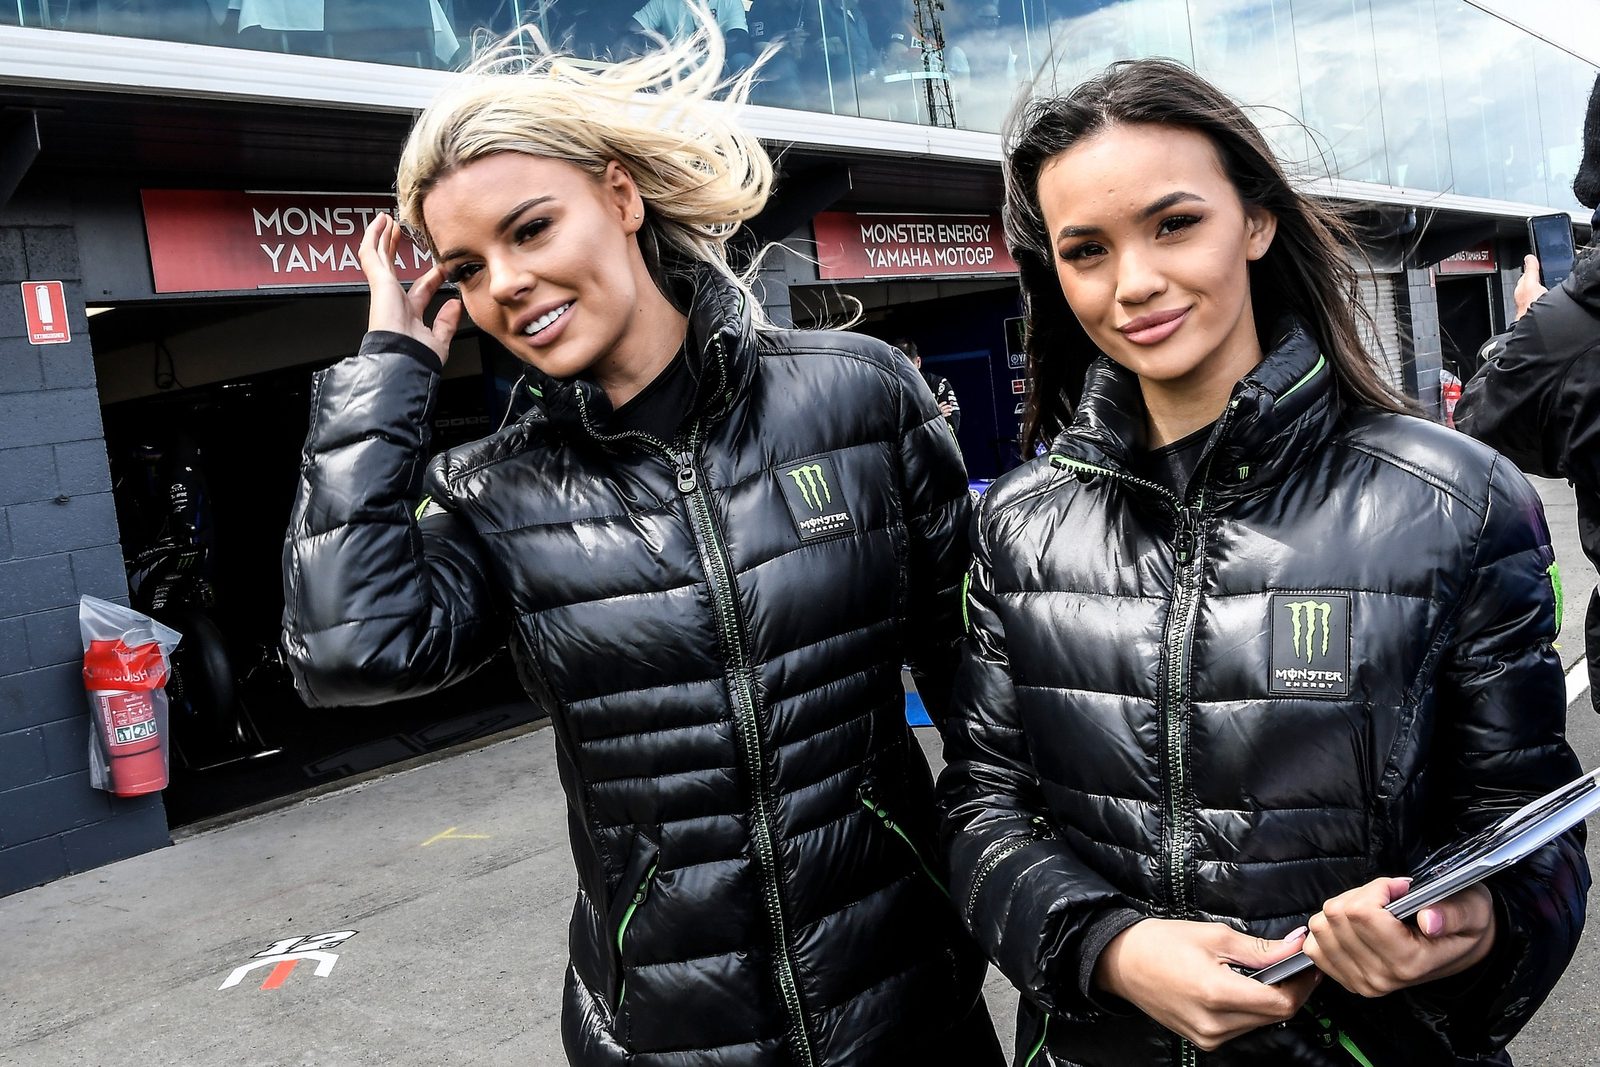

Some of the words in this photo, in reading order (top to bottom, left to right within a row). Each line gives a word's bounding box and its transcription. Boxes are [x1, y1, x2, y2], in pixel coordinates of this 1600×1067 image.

[252, 207, 404, 237] MONST
[860, 223, 935, 244] MONSTER
[938, 223, 991, 243] ENERGY
[260, 243, 406, 273] YAMA
[865, 248, 933, 268] YAMAHA
[934, 246, 994, 266] MOTOGP
[800, 512, 849, 530] MONSTER
[810, 522, 844, 533] ENERGY
[1275, 667, 1343, 682] MONSTER
[1285, 681, 1333, 689] ENERGY
